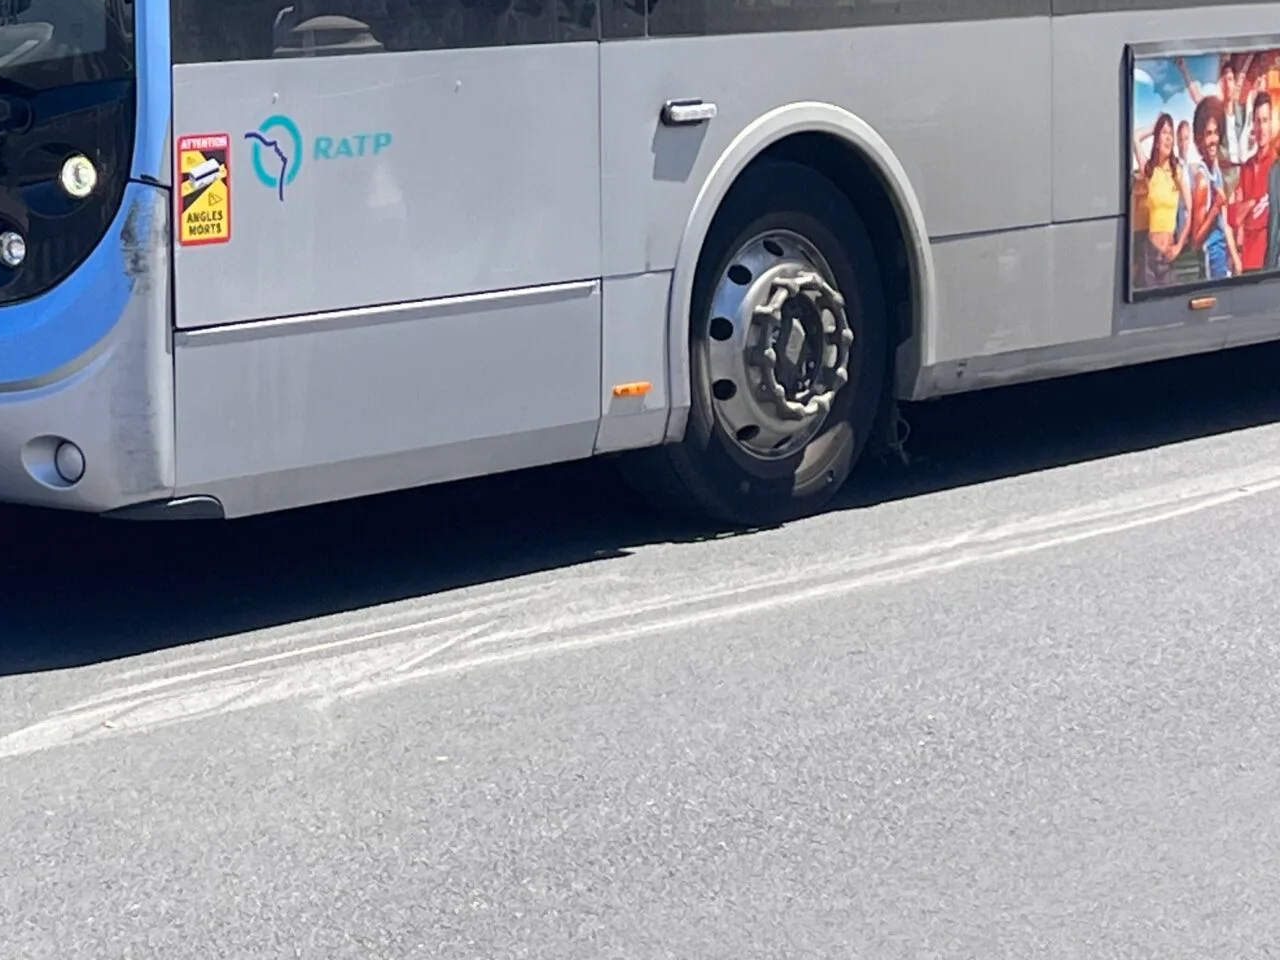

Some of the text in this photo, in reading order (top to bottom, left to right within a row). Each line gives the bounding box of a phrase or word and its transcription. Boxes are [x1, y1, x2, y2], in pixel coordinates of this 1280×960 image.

[312, 132, 394, 162] RATP
[186, 209, 224, 224] ANGLES
[188, 222, 222, 236] MORTS
